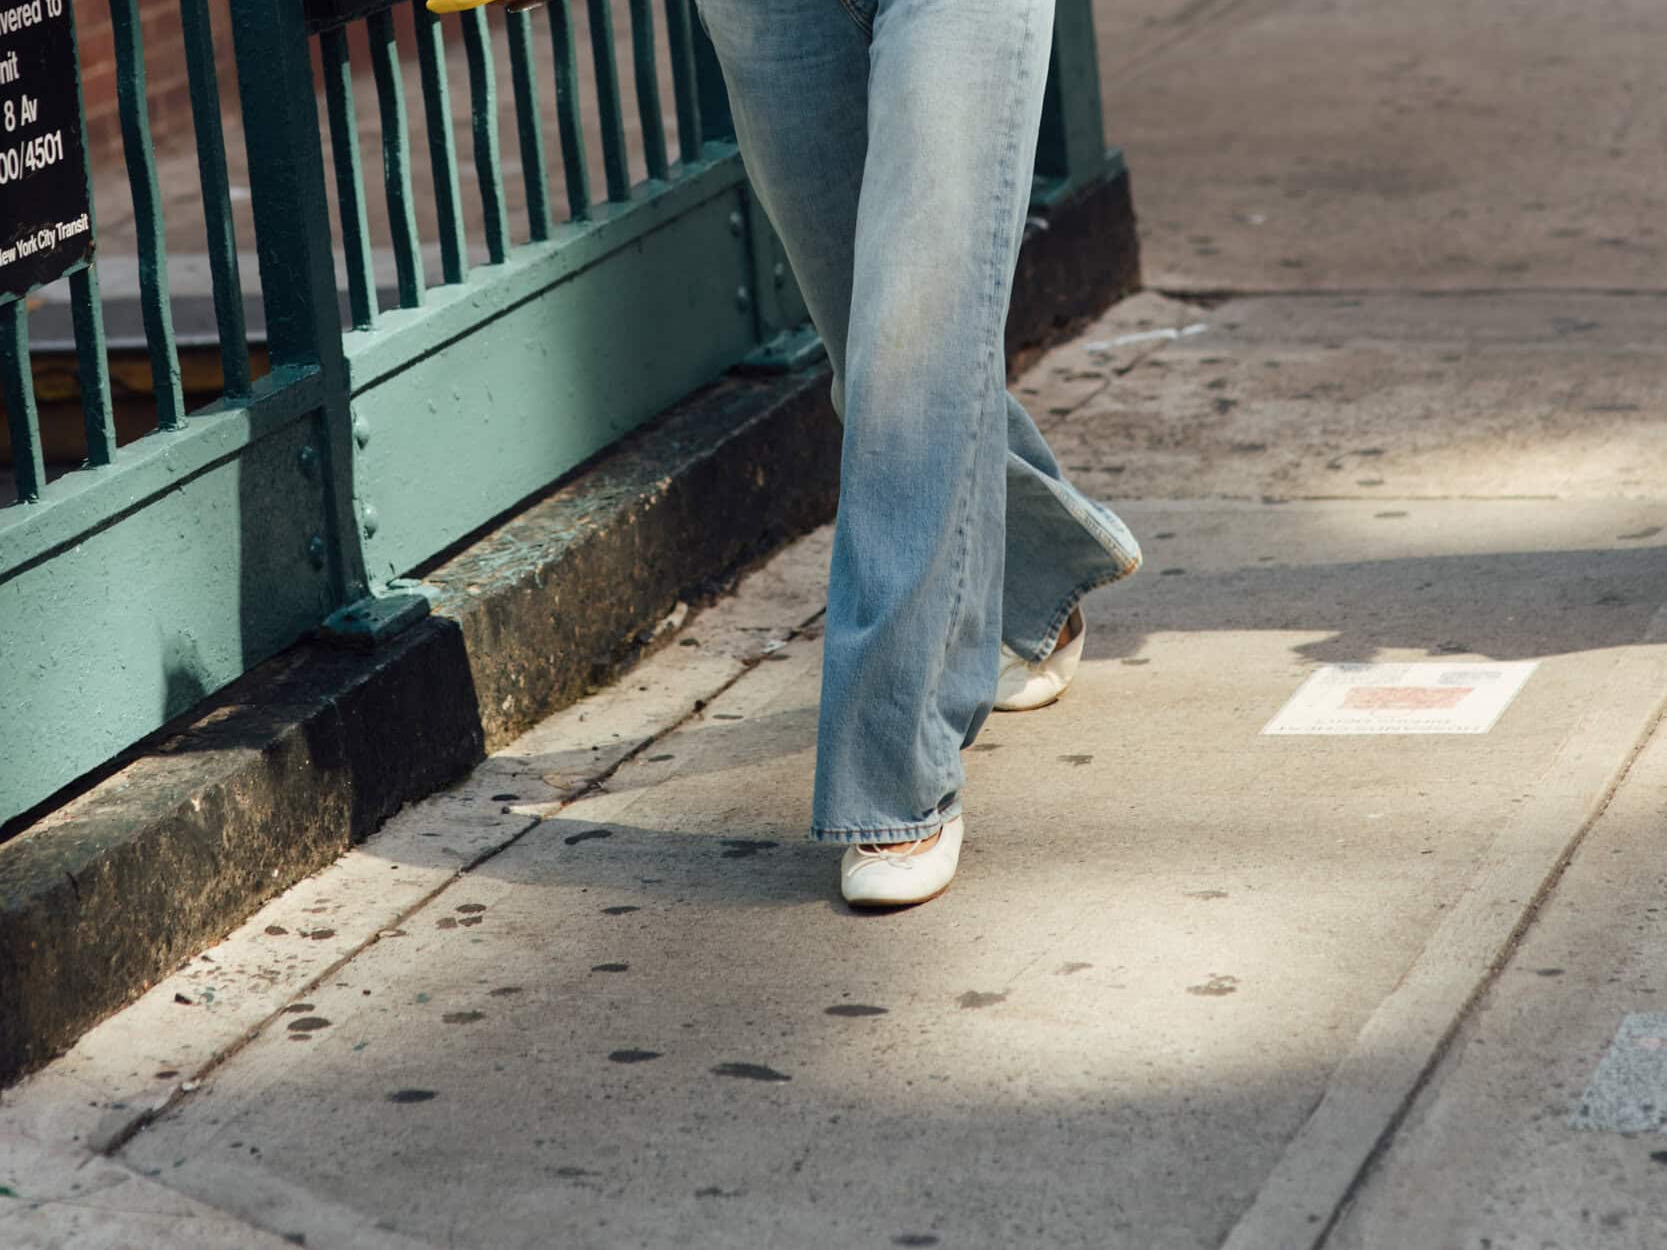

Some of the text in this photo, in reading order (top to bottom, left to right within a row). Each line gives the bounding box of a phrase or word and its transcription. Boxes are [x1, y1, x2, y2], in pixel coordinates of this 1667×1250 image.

[4, 94, 38, 132] 8 Av
[0, 130, 63, 184] 00/4501
[16, 234, 38, 259] York
[37, 229, 56, 250] City
[55, 213, 89, 241] Transit
